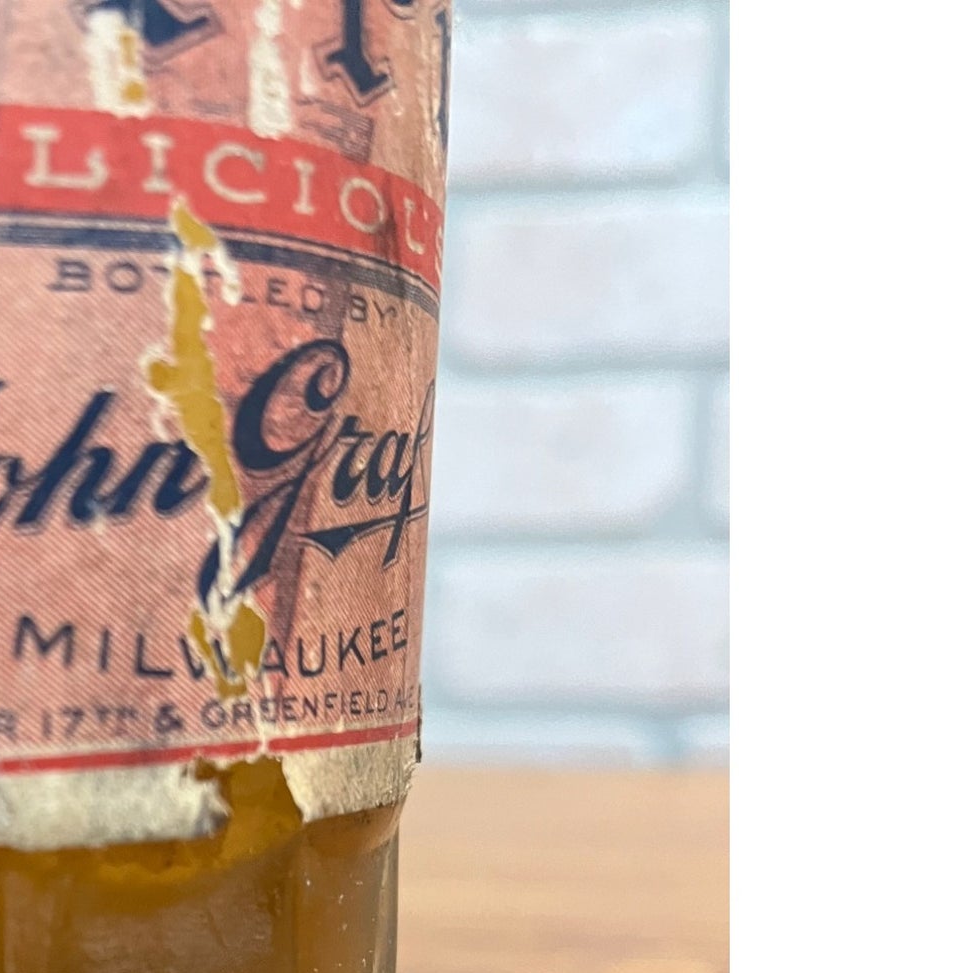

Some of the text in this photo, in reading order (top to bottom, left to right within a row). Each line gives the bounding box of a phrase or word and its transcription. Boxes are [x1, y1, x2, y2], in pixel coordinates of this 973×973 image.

[48, 258, 399, 327] BOTED BY
[153, 702, 184, 735] &
